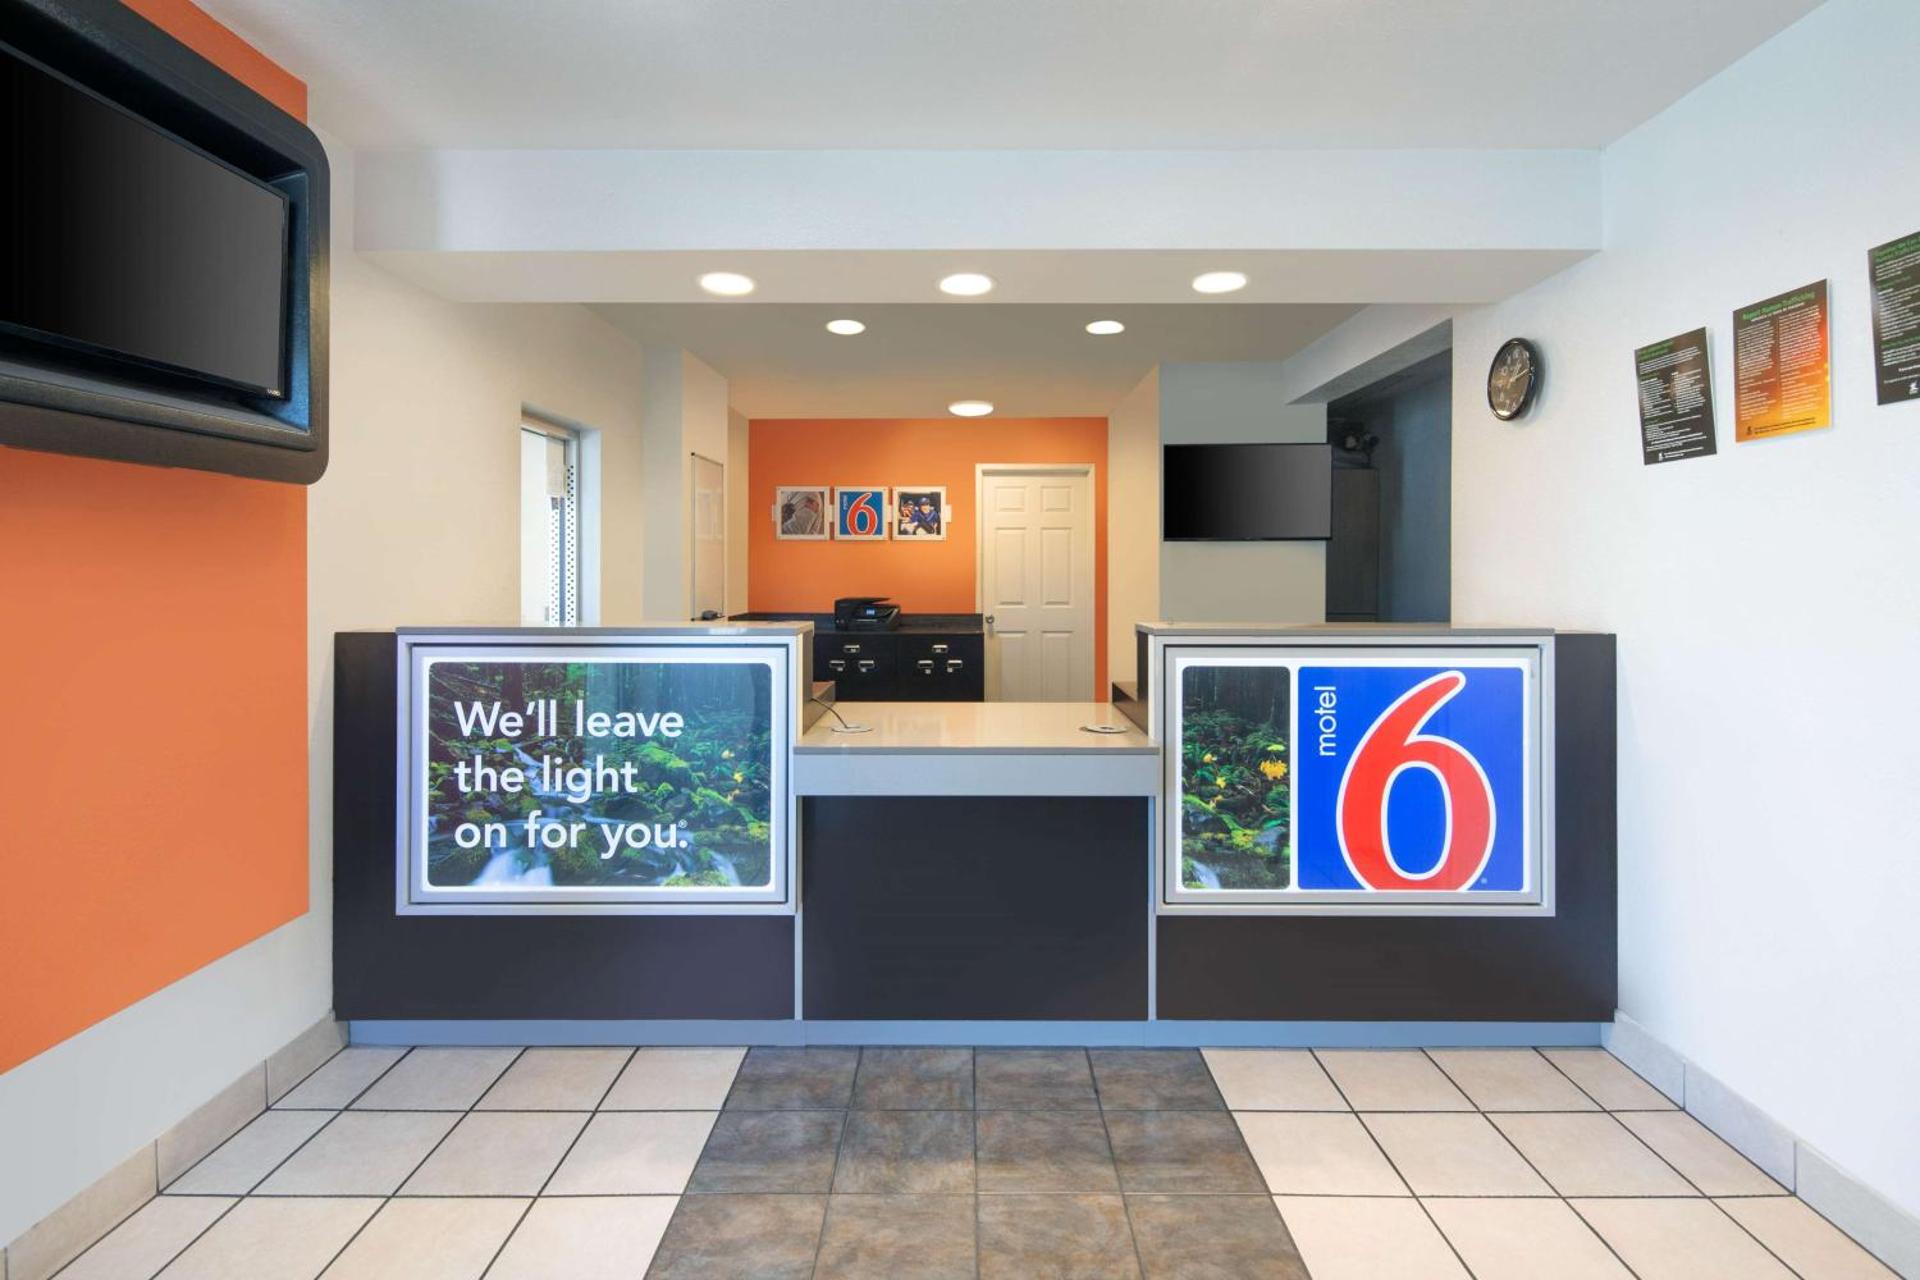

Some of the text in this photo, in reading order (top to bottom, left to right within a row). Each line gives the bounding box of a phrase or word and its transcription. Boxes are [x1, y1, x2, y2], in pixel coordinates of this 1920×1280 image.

[847, 492, 878, 536] 6
[454, 700, 684, 737] We'll leave
[1314, 686, 1337, 757] motel
[454, 755, 638, 804] the light
[1336, 669, 1497, 892] 6
[454, 822, 507, 849] on
[524, 810, 586, 848] for
